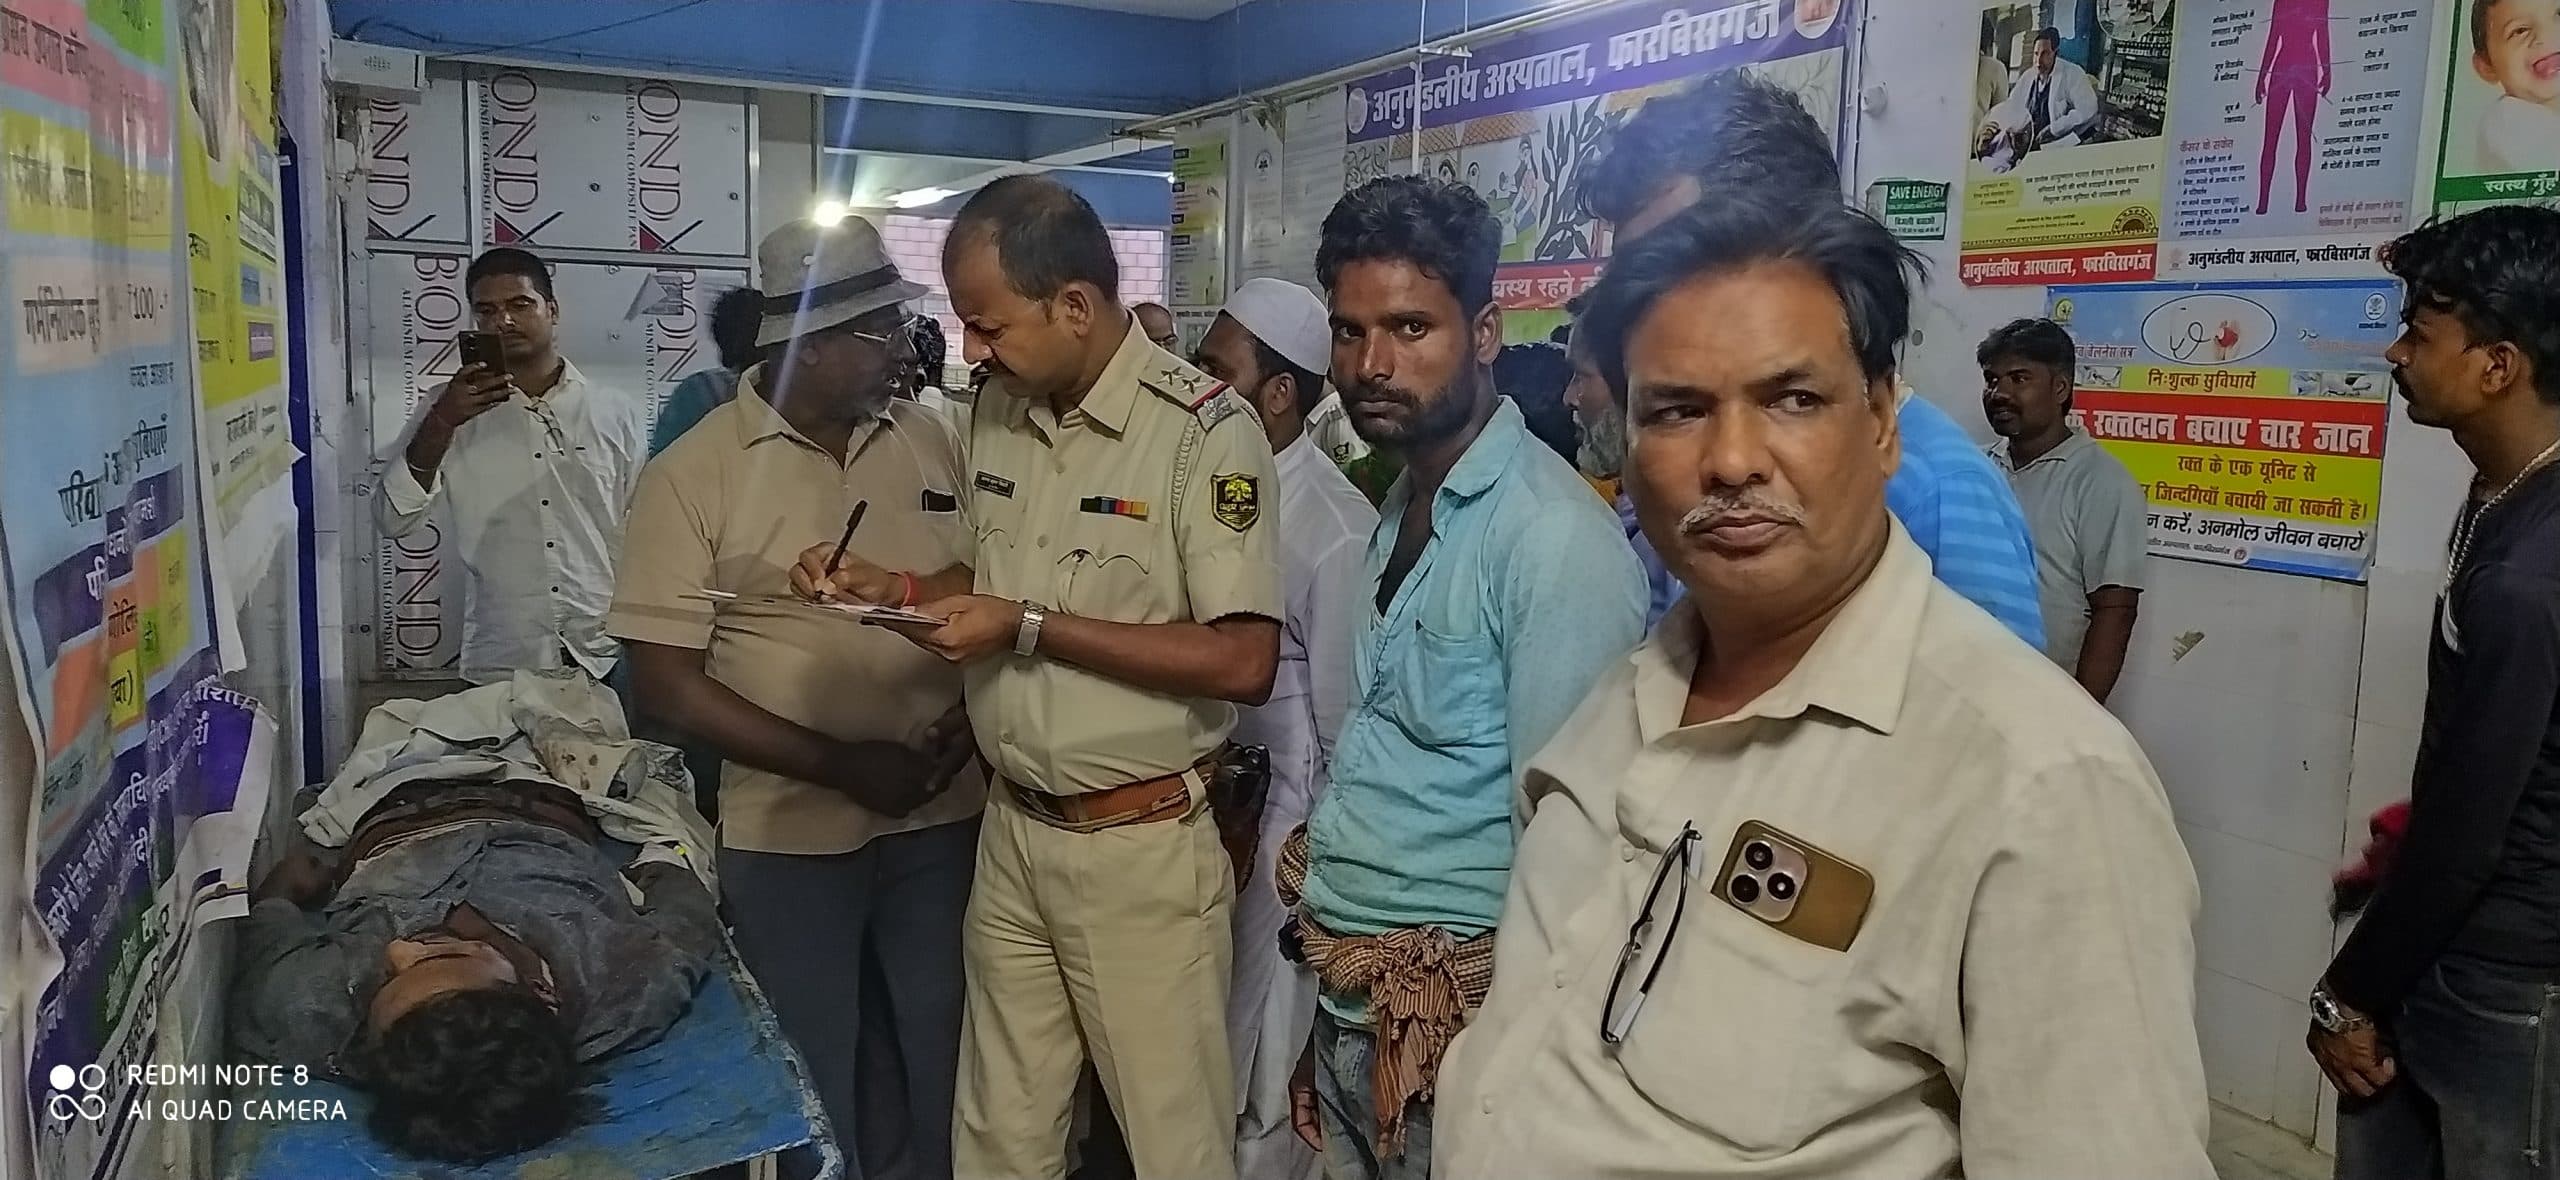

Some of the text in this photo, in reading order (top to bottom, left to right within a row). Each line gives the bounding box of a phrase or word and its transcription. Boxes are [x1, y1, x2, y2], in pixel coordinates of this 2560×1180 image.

[1484, 43, 1596, 99] अस्पताल,
[1889, 185, 1944, 200] SAVE ENERGY
[2484, 178, 2529, 193] स्वस्थ
[2188, 243, 2371, 270] अनुमंडलीय अस्पताल, फारबिसगंज
[1537, 269, 1575, 299] रहने
[2148, 368, 2201, 391] निःशुल्क
[2093, 410, 2178, 441] रक्तदान
[2185, 415, 2252, 446] बचाए
[2259, 418, 2305, 450] चार
[2312, 422, 2373, 454] जान
[2177, 454, 2317, 484] रक्त के एक यूनिट से
[2224, 490, 2268, 511] बचायी
[2273, 496, 2292, 514] जा
[2300, 497, 2345, 519] सकती
[2198, 518, 2261, 542] अनमोल
[2265, 521, 2313, 548] जीवन
